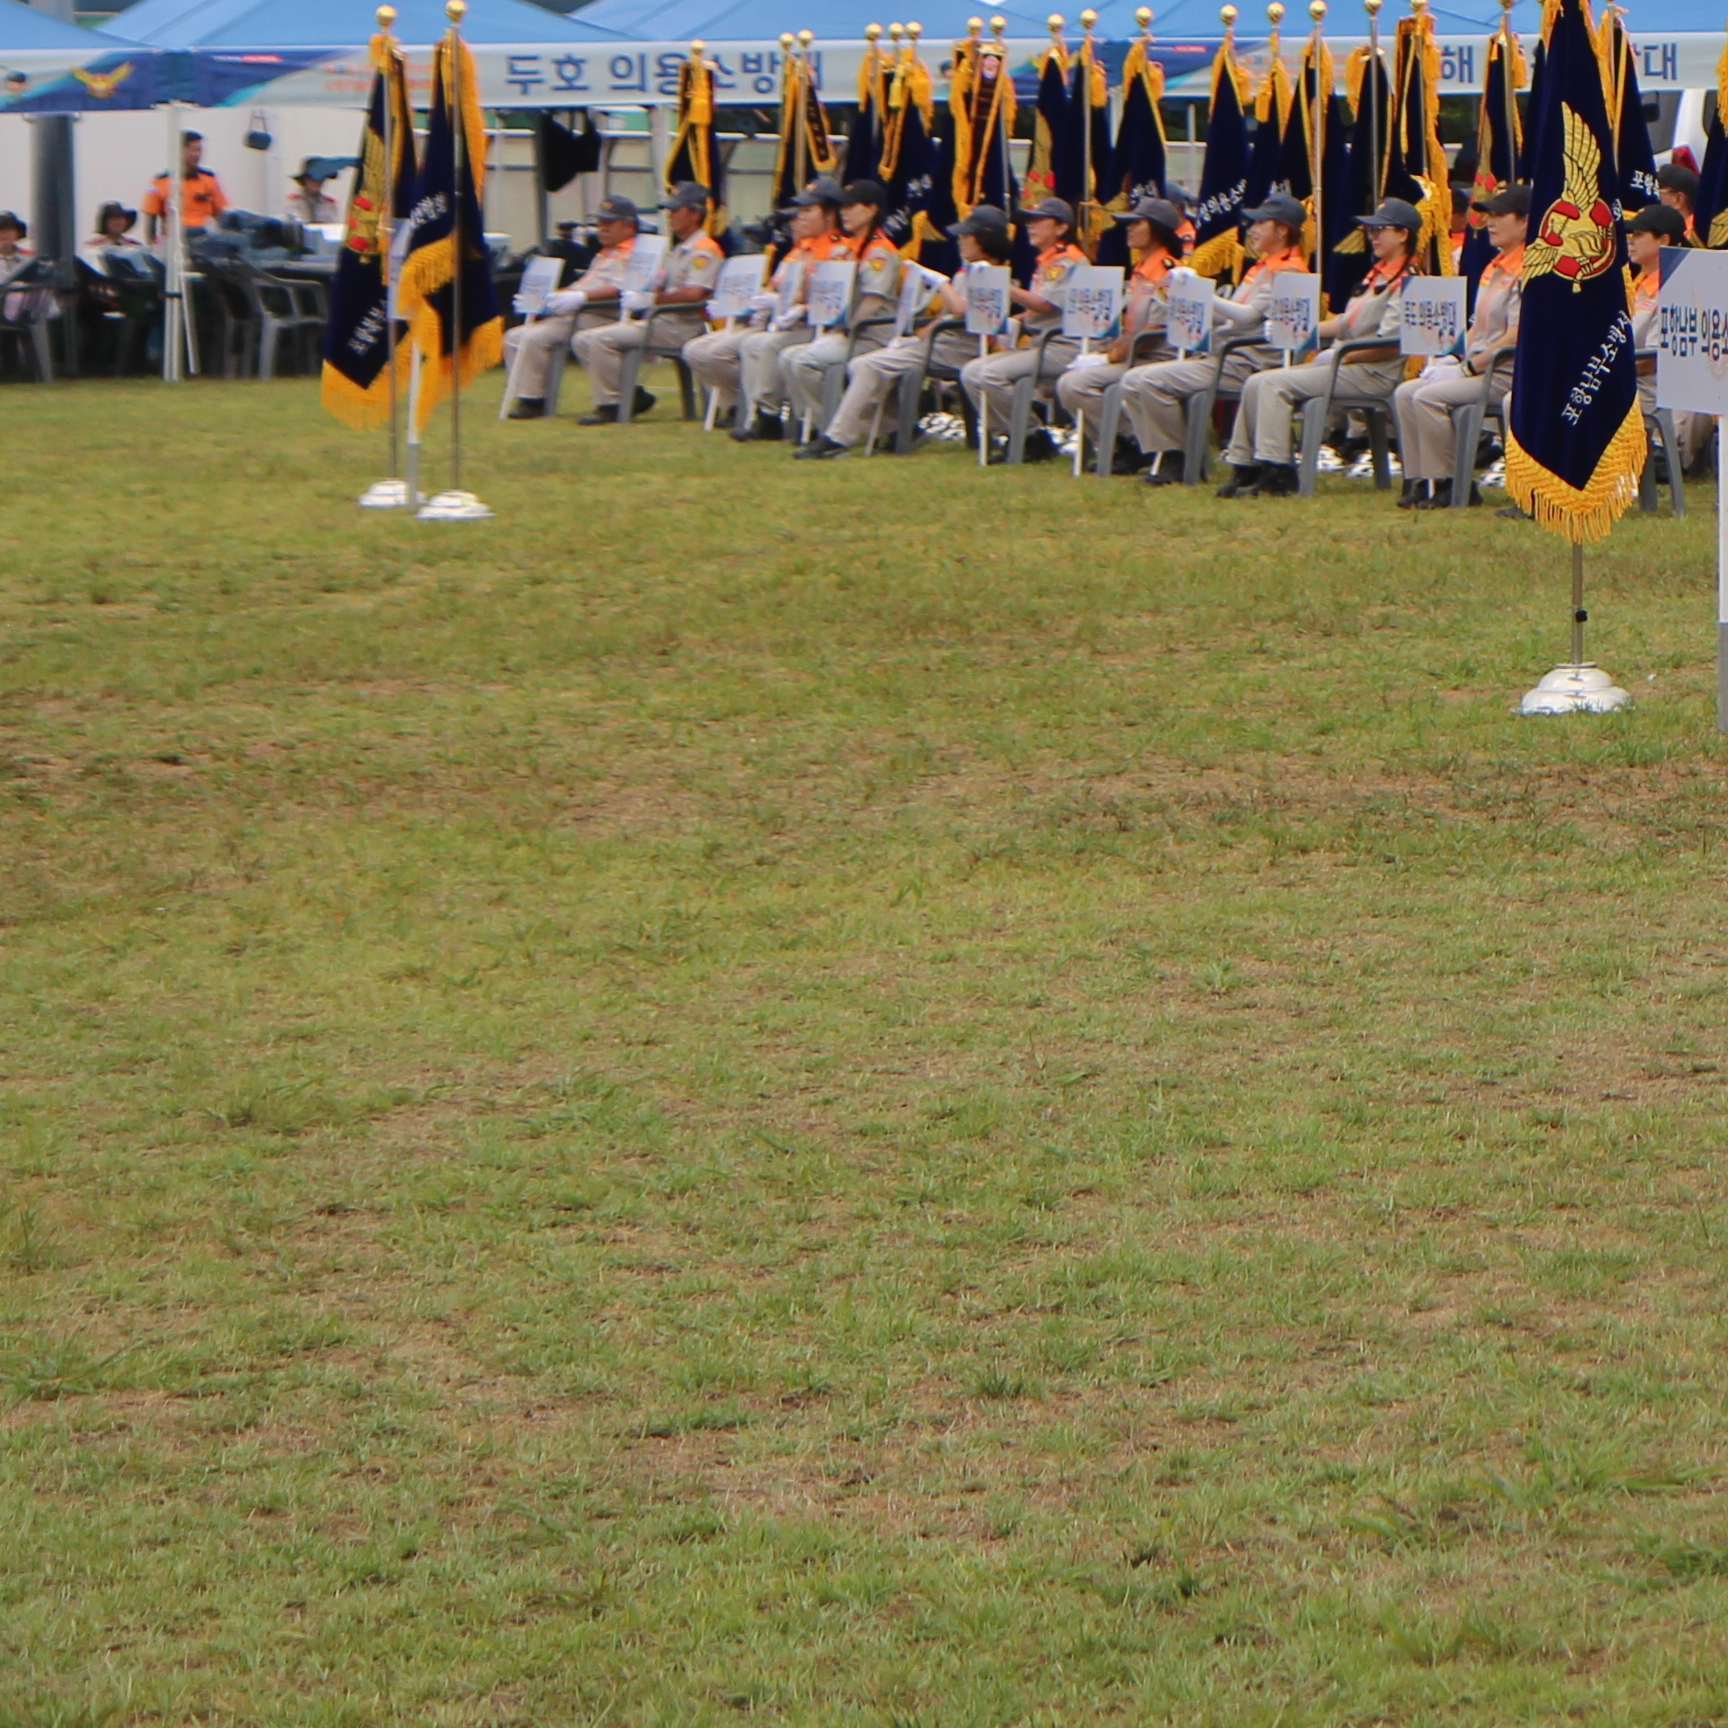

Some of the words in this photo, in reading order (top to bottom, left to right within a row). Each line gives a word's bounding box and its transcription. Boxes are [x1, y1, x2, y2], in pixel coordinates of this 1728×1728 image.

[505, 52, 591, 95] 두호
[1660, 303, 1698, 358] 포항남부
[1561, 309, 1631, 426] 포항남부소방서
